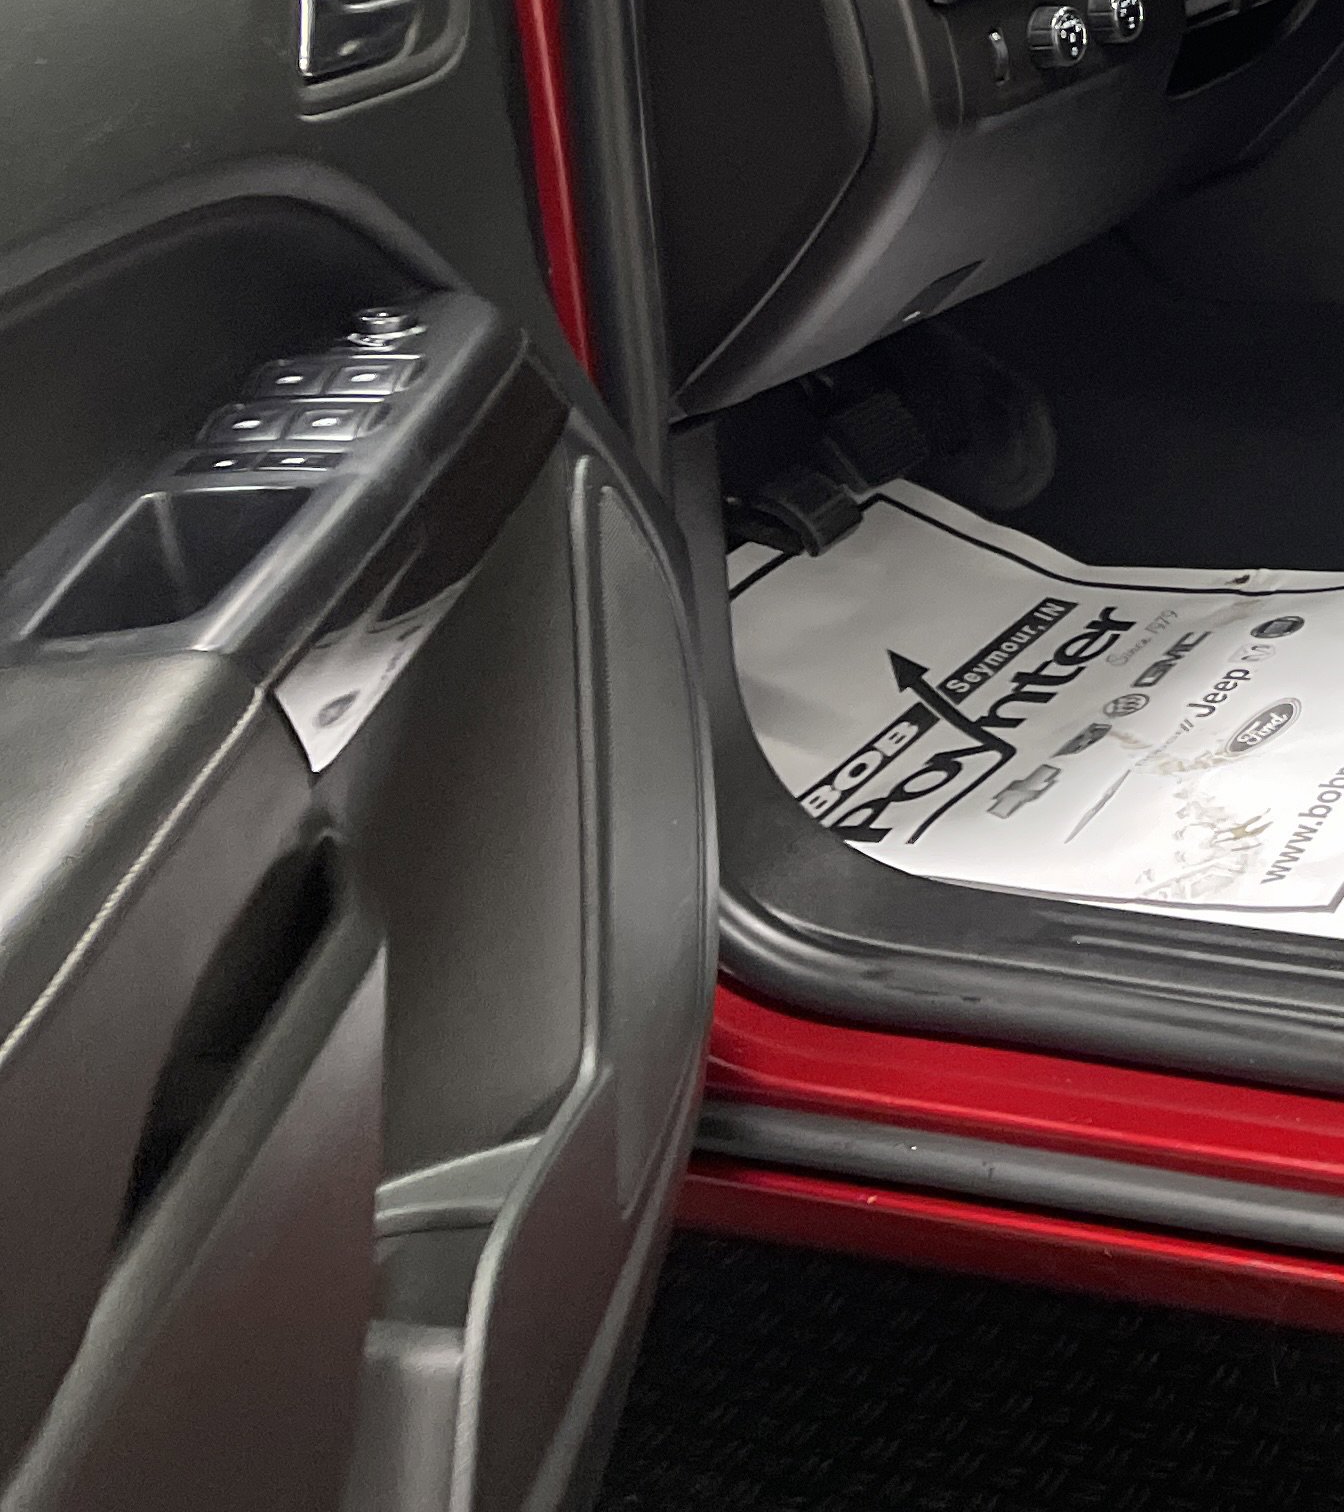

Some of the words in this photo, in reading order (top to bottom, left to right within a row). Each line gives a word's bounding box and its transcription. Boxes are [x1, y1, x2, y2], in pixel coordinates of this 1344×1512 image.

[946, 624, 1045, 694] Seymour,
[1033, 601, 1066, 618] IN
[1131, 631, 1212, 688] GMC
[1186, 668, 1251, 718] Jeep
[1237, 712, 1288, 746] Ford
[801, 721, 919, 819] BOB
